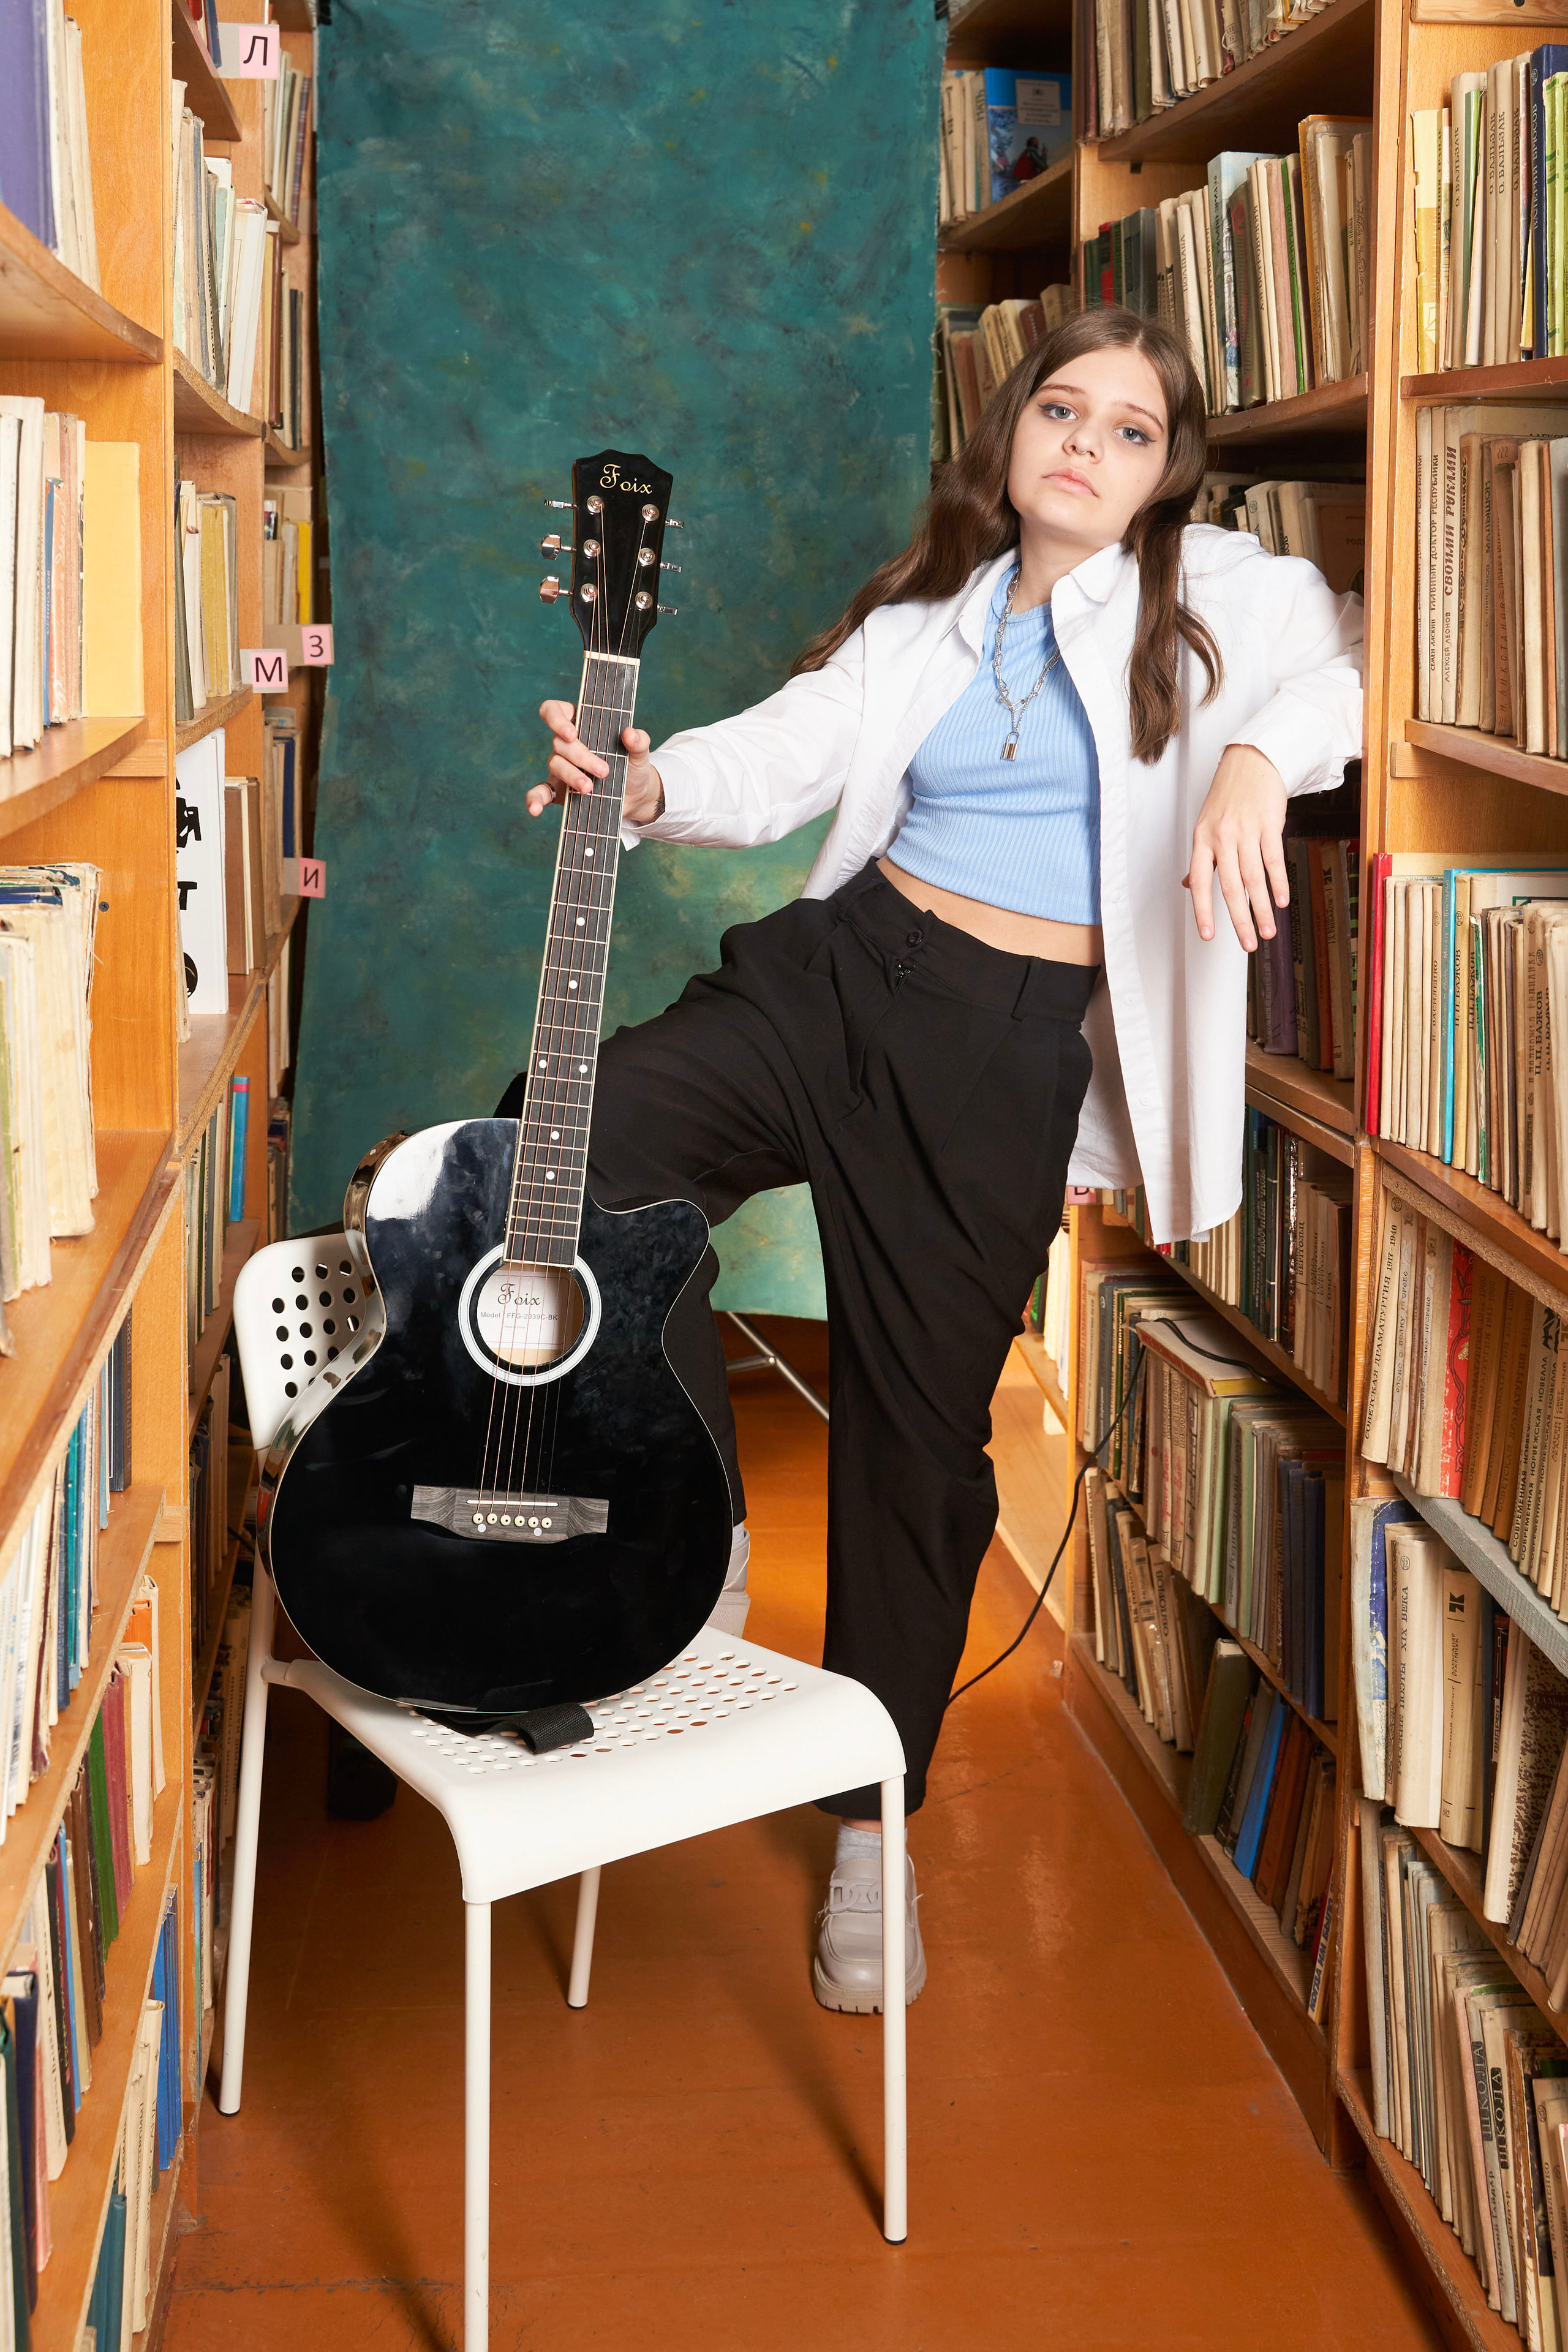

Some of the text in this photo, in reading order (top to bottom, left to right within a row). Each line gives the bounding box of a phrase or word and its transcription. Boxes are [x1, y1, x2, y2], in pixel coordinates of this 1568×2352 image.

[243, 36, 268, 66] Л
[600, 464, 653, 494] Foix
[1446, 445, 1457, 516] РУКАМИ
[1444, 524, 1454, 596] СВОИМИ
[255, 657, 282, 682] М
[309, 635, 324, 658] З
[304, 867, 318, 889] И
[497, 1283, 541, 1305] Foix
[1364, 1369, 1379, 1440] СОВЕТСКАЯ
[1373, 1275, 1390, 1367] ДРАМАТУРГИЯ
[1497, 1444, 1512, 1512] СОВЕТСКАЯ
[1509, 1352, 1526, 1441] ДРАМАТУРГИЯ
[1520, 1357, 1548, 1561] СОВРЕМЕННАЯ НОРВЕЖСКАЯ НОВЕЛЛА
[1539, 1414, 1551, 1483] НОРВЕЖСКАЯ
[1512, 1470, 1528, 1548] СОВРЕМЕННАЯ
[1308, 1967, 1322, 2013] КОГДА
[1471, 2045, 1492, 2135] ШКОЛА
[1491, 2072, 1509, 2162] ШКОЛА
[1544, 2162, 1556, 2241] ВАСИЛЕНКО
